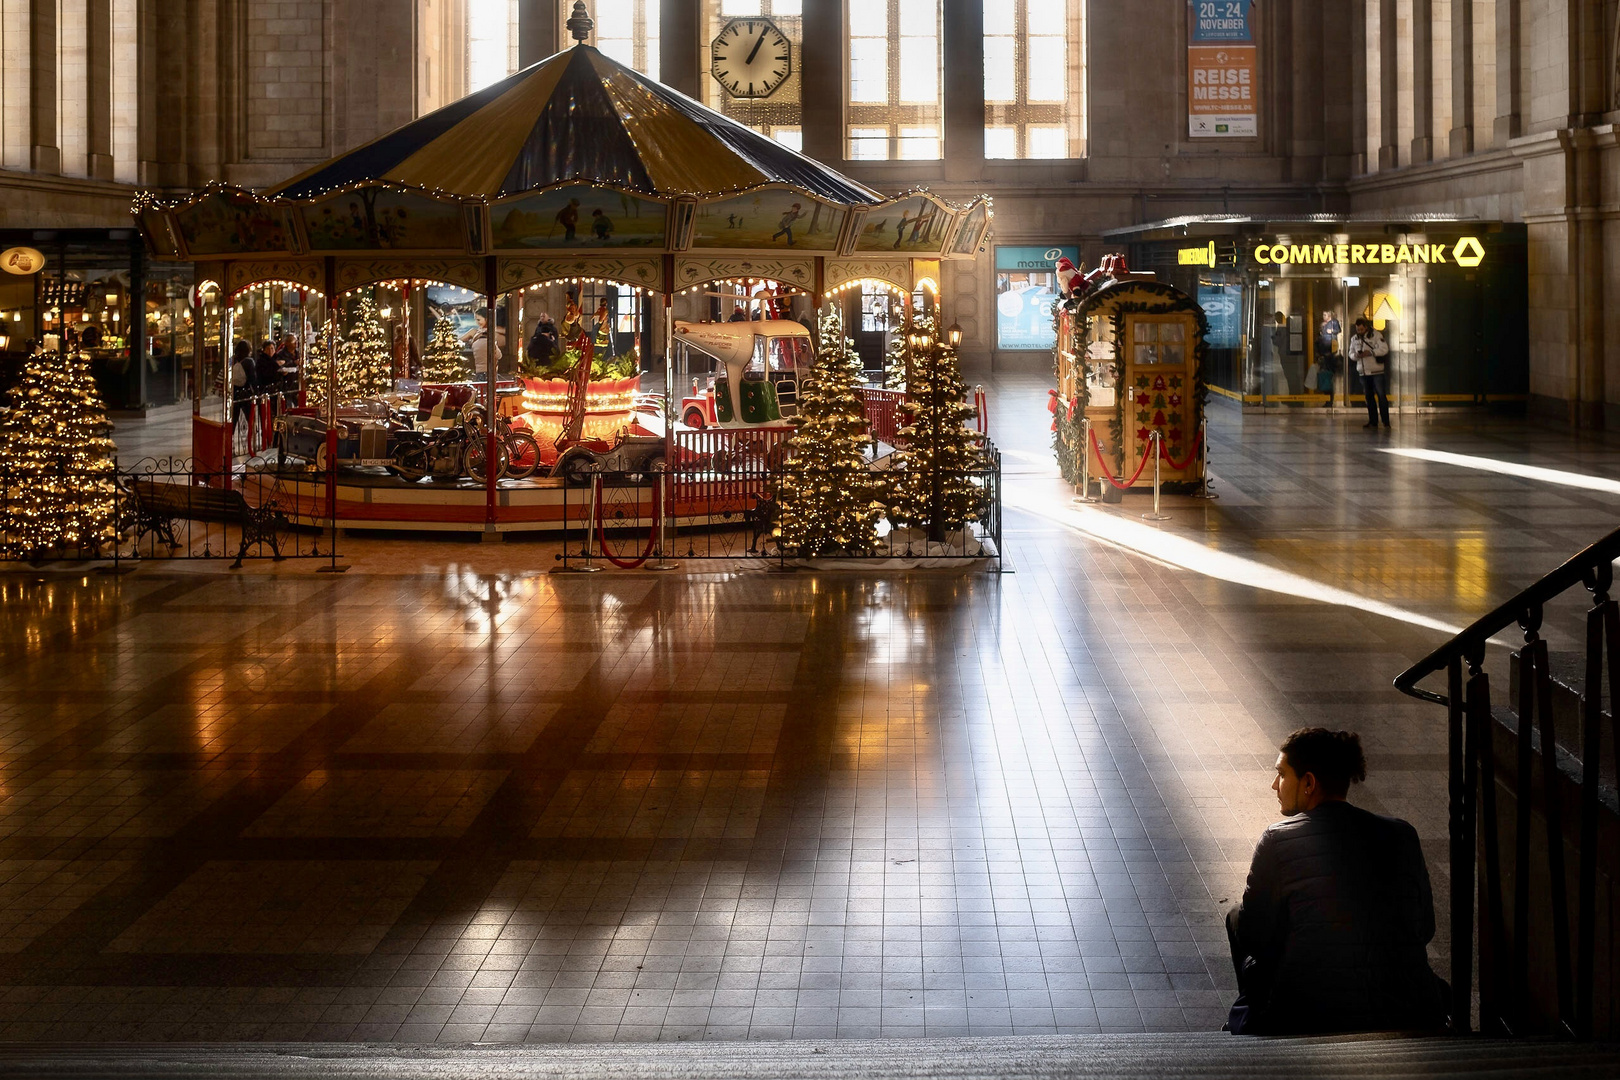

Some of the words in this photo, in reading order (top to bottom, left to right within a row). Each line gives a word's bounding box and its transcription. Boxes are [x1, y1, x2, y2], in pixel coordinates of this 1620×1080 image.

[1200, 19, 1244, 30] NOVEMBER
[1194, 69, 1251, 85] REISE
[1194, 86, 1251, 100] MESSE
[1254, 243, 1447, 264] COMMERZBANK
[1017, 260, 1051, 268] MOTEL
